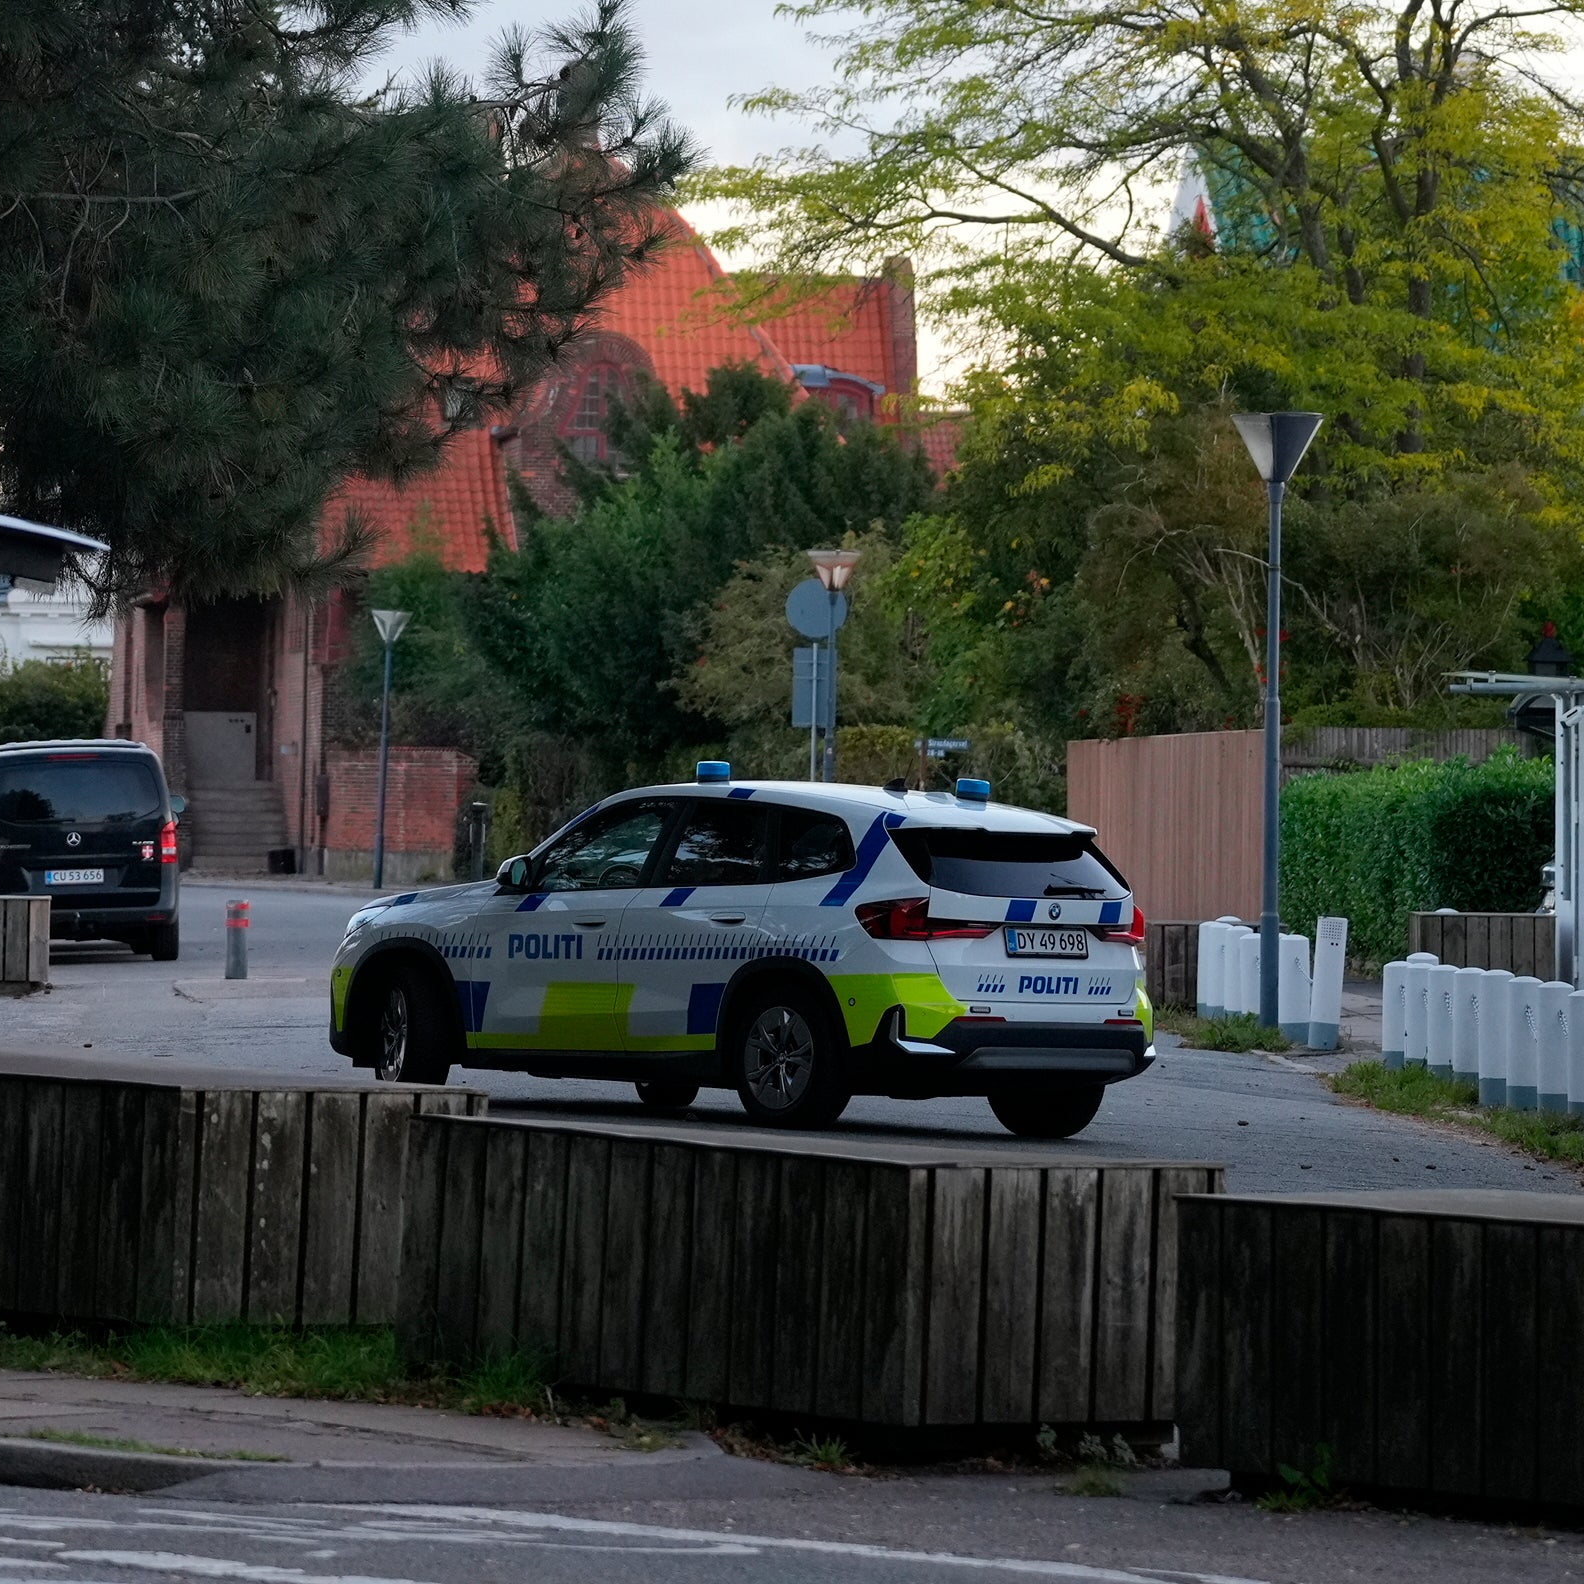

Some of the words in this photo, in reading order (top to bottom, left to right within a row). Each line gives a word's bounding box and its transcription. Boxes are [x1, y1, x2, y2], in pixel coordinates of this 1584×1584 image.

[53, 871, 66, 881] CU
[69, 871, 81, 881] 53
[83, 870, 102, 881] 656
[508, 933, 583, 960] POLITI
[1017, 932, 1035, 950] DY
[1040, 932, 1056, 951] 49
[1059, 933, 1084, 952] 698
[1018, 975, 1079, 995] POLITI
